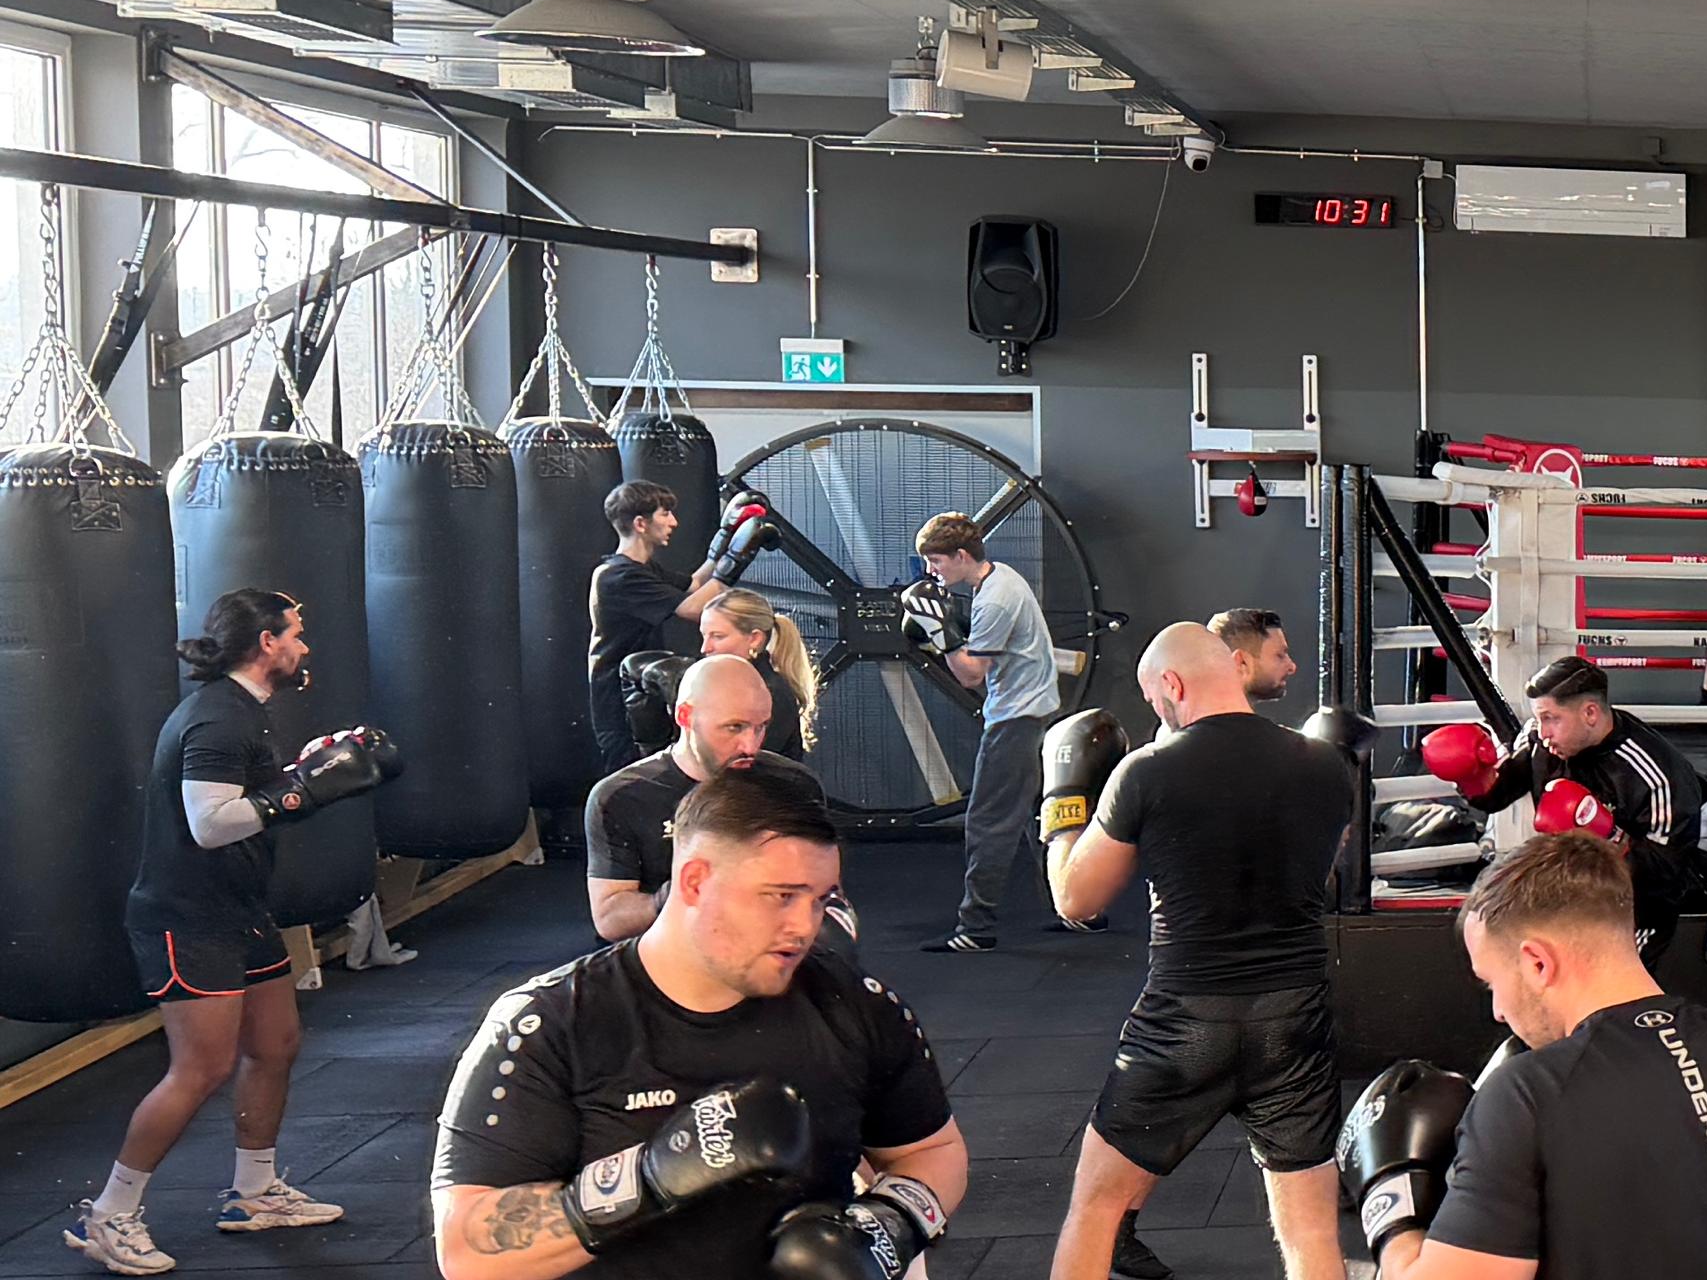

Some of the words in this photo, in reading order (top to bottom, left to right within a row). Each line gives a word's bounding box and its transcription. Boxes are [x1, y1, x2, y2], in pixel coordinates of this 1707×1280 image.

[1314, 200, 1391, 223] 10:31
[1578, 635, 1612, 647] FUCHS
[624, 1089, 677, 1111] JAKO
